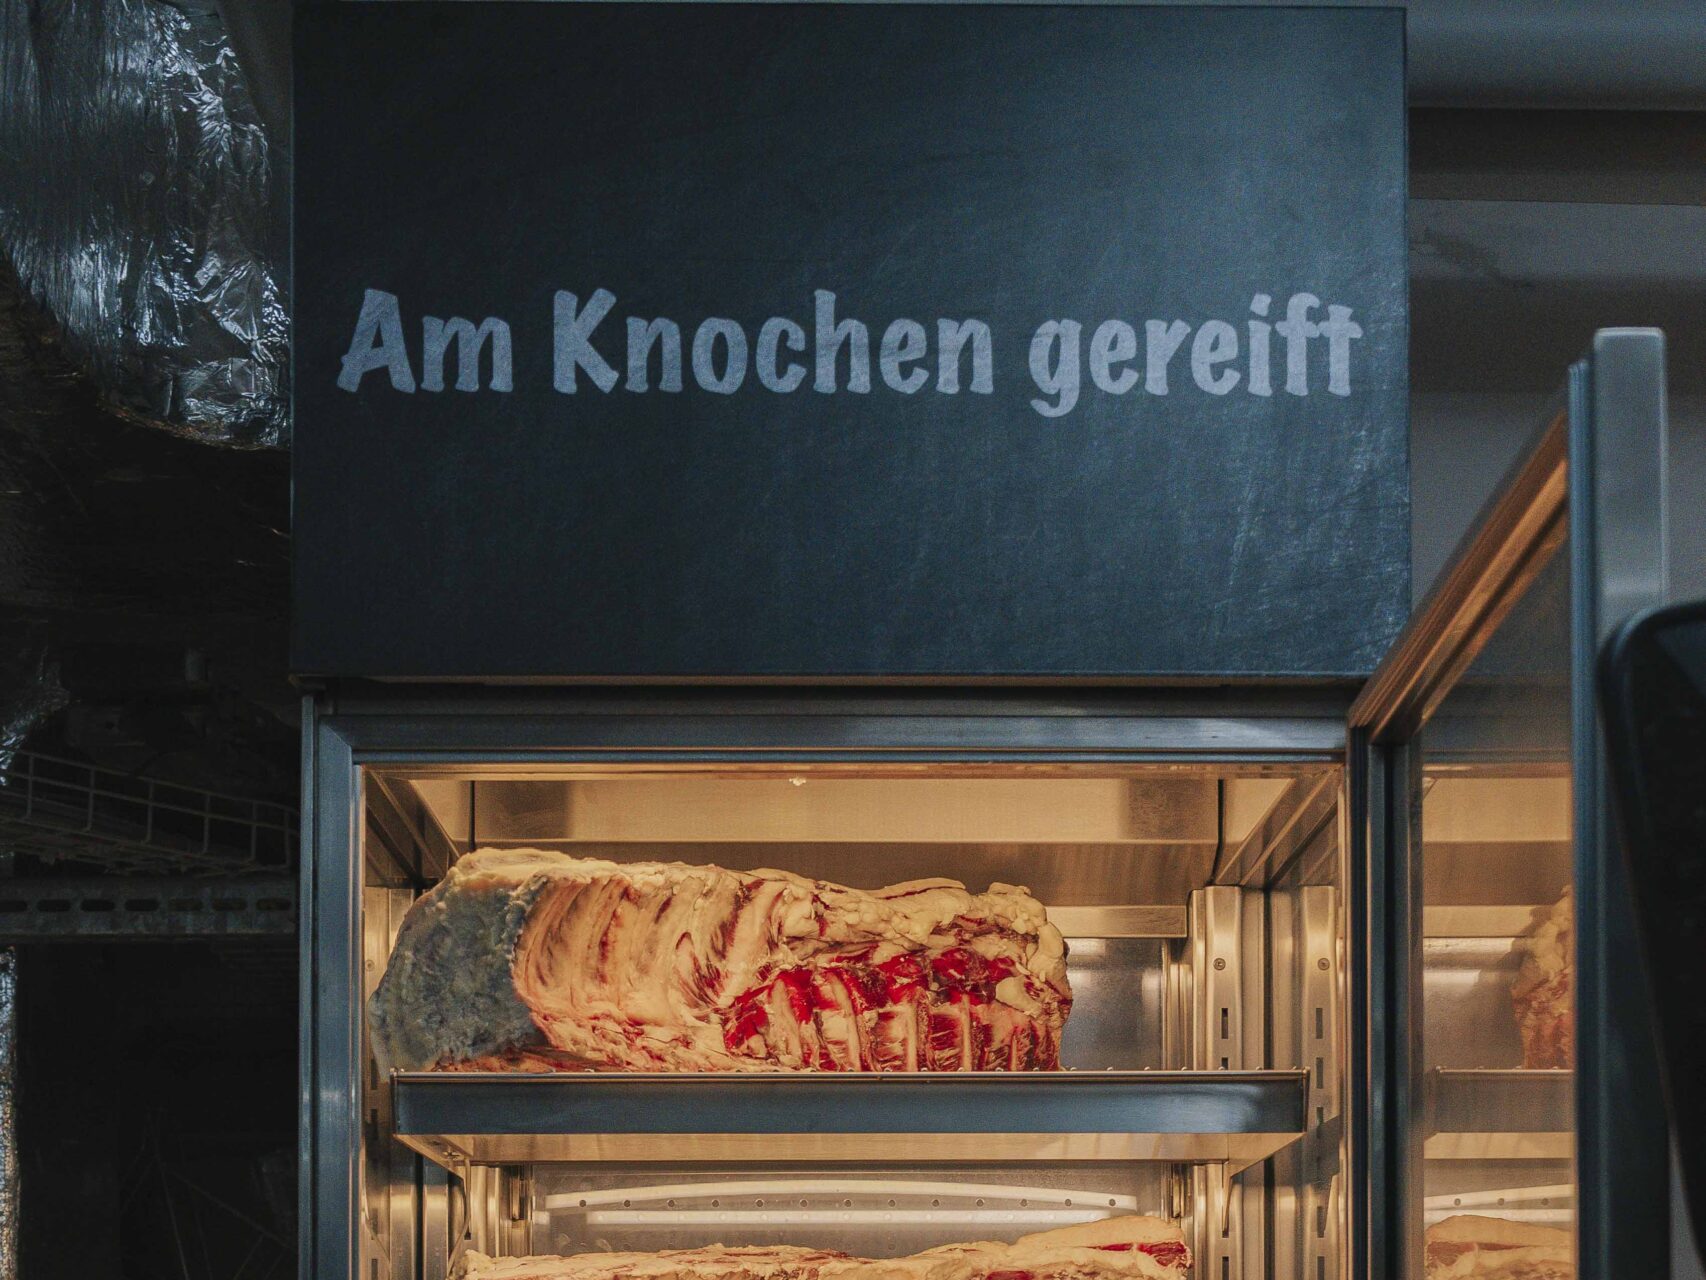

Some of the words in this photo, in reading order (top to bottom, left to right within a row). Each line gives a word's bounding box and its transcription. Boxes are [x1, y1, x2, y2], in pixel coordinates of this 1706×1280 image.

[337, 287, 514, 394] Am
[552, 287, 995, 396] Knochen
[1027, 291, 1364, 418] gereift
